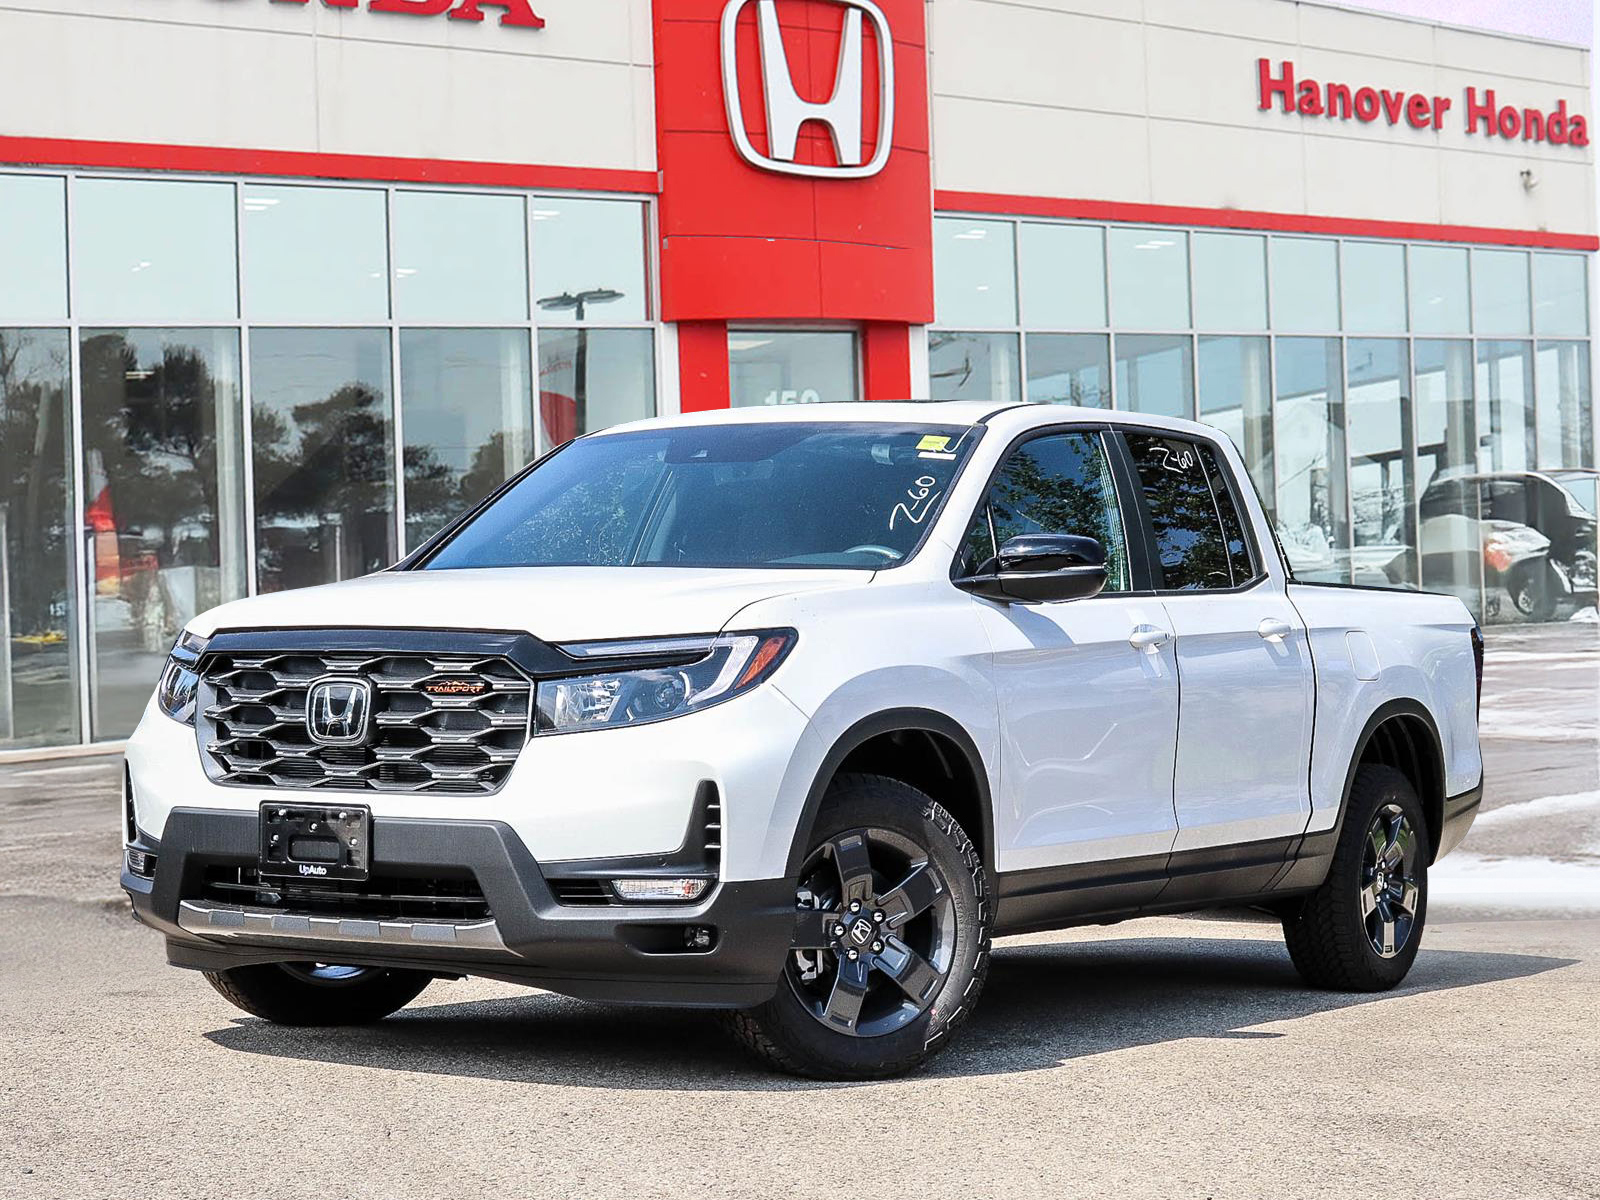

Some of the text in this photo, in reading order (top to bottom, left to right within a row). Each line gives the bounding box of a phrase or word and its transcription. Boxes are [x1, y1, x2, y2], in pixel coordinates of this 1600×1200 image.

[1257, 57, 1591, 148] Hanover Honda
[425, 685, 484, 693] TRAILSPORT
[298, 864, 327, 875] UpAuto
